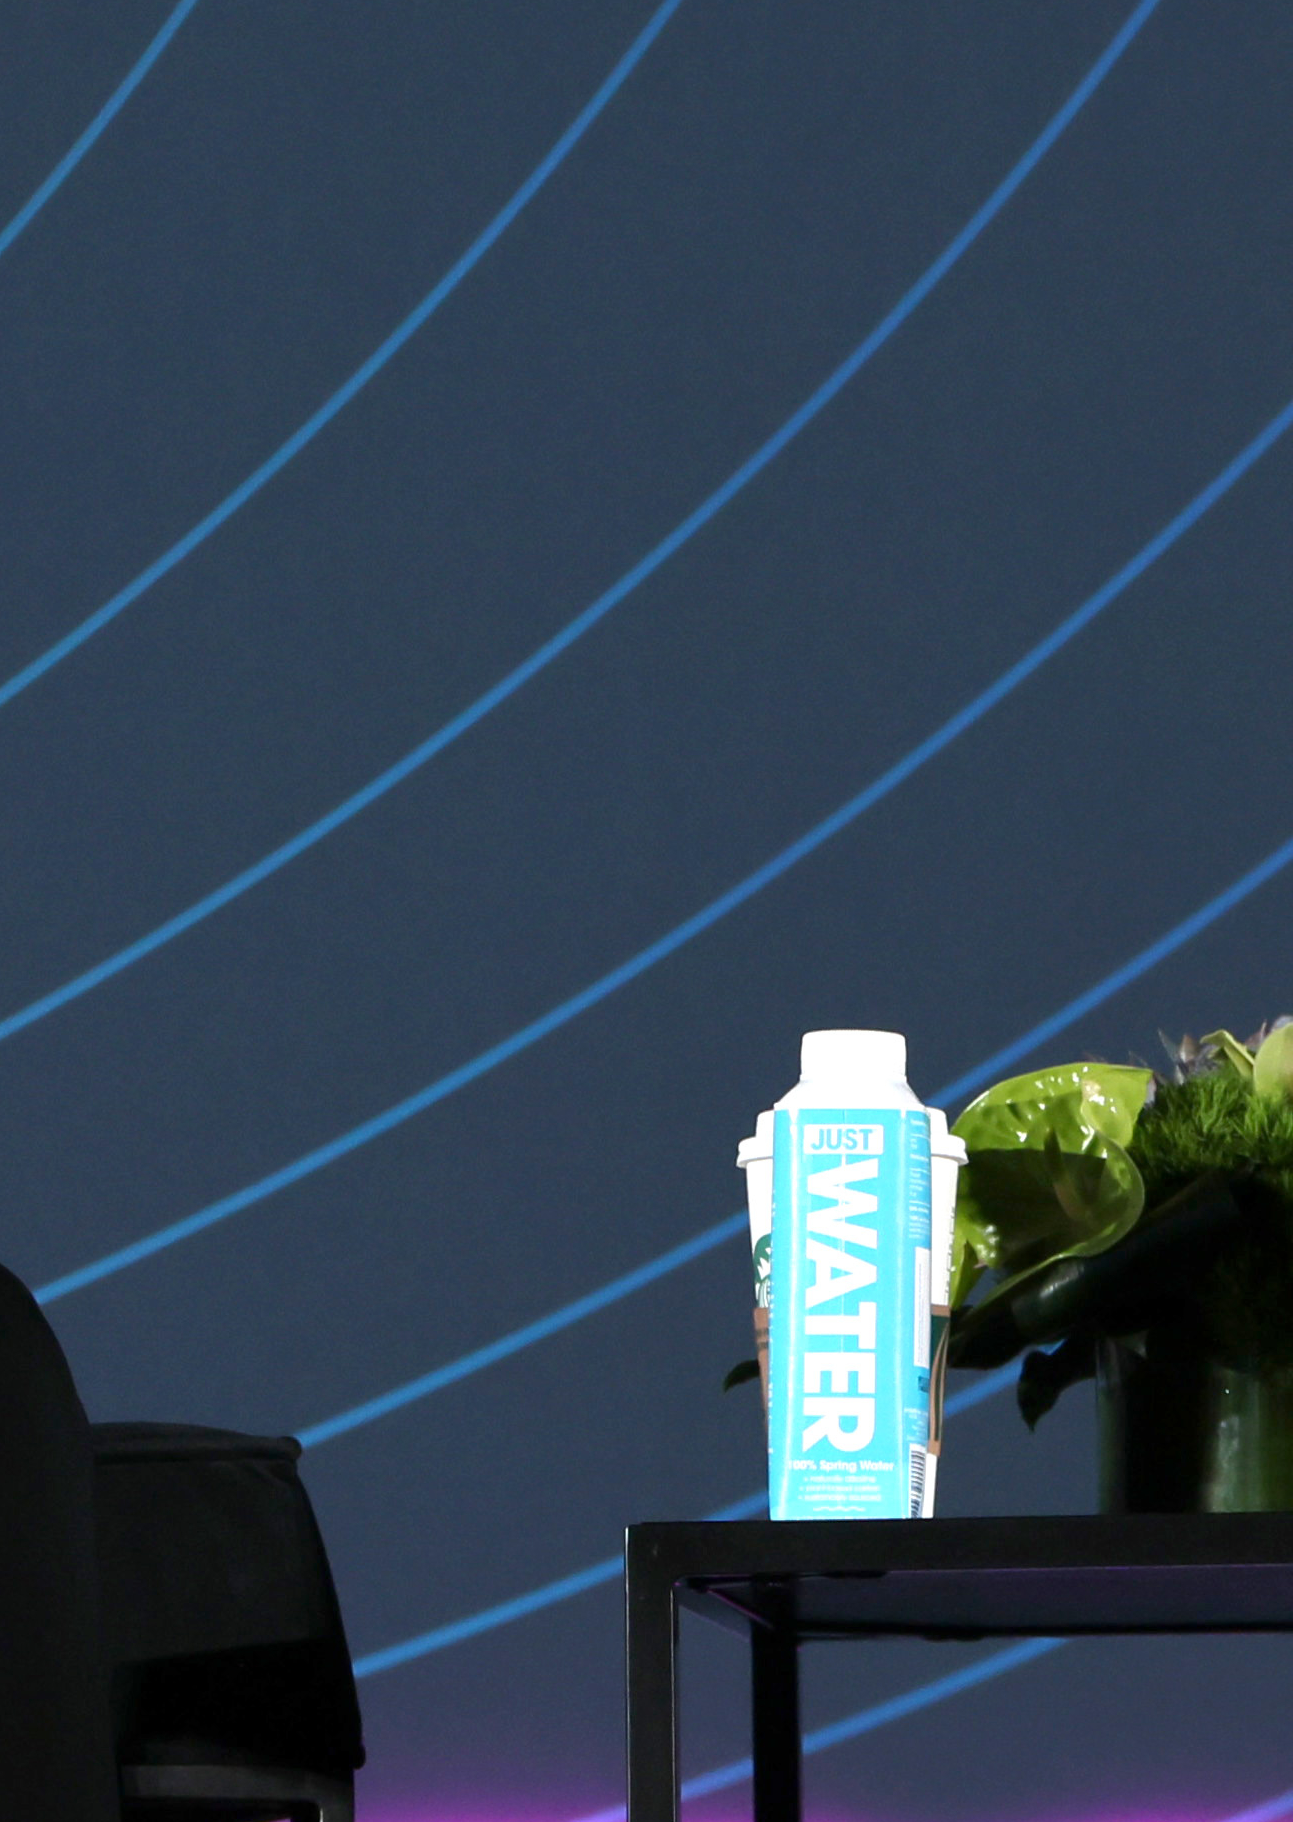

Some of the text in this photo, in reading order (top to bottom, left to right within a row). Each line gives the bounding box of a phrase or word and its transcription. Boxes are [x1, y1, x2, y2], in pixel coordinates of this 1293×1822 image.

[811, 1128, 874, 1151] JUST
[802, 1158, 879, 1452] WATER
[789, 1459, 894, 1473] 100% Spring Water
